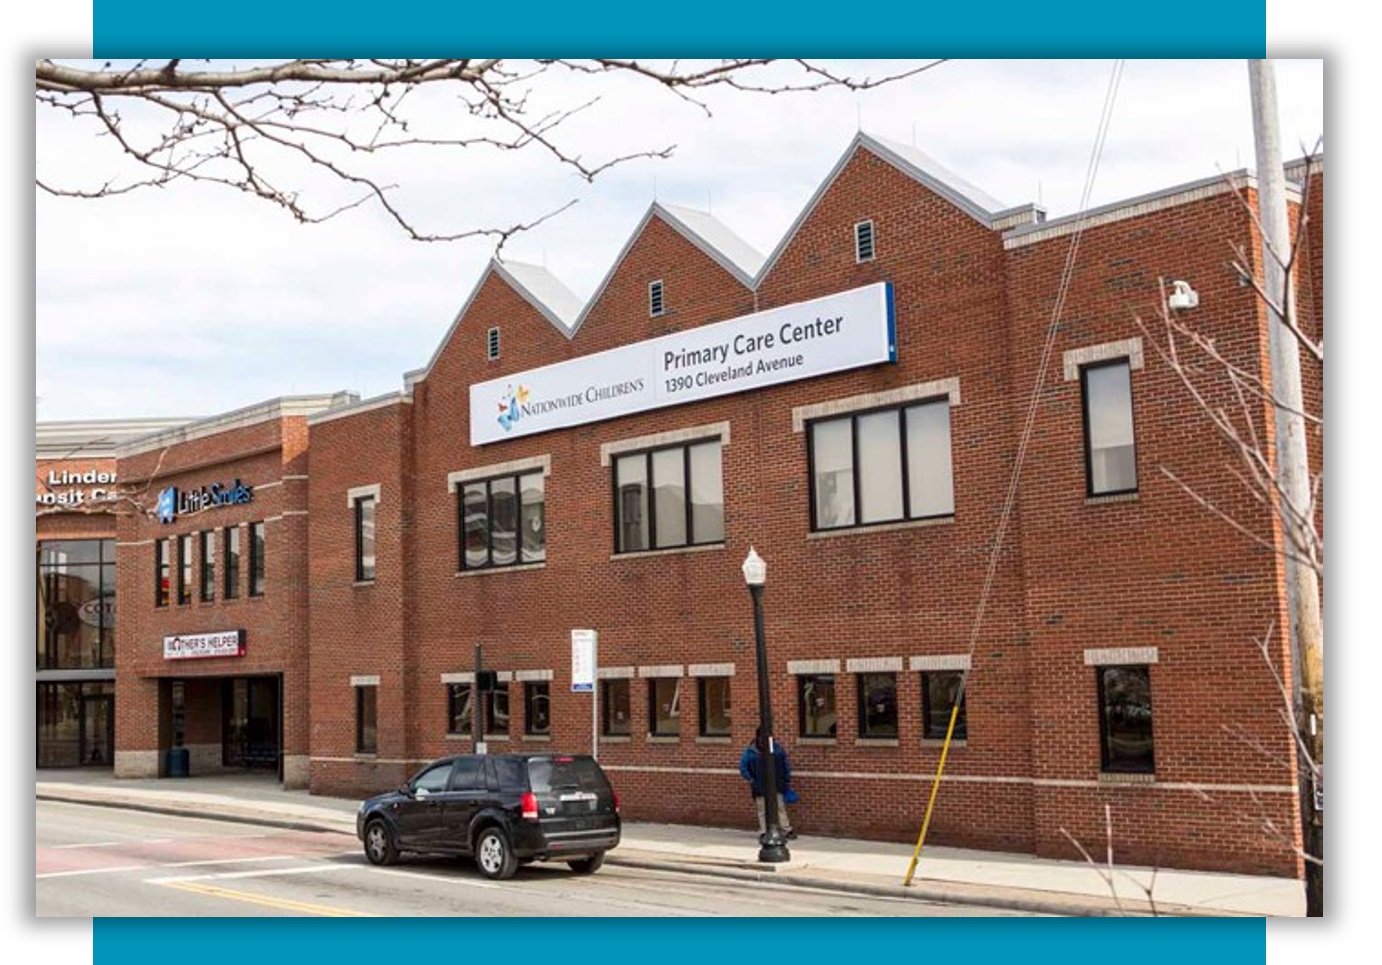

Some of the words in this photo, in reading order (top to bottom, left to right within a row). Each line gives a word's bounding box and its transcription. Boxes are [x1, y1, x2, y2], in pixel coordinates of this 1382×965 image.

[664, 343, 730, 371] Primary
[733, 332, 774, 356] Care
[779, 316, 844, 345] Center
[665, 375, 693, 393] 1390
[696, 361, 753, 386] Cleveland
[756, 354, 804, 374] Avenue
[521, 393, 584, 417] NATIONWIDE
[585, 378, 645, 404] CHILDREN'S
[208, 634, 238, 649] HELPER
